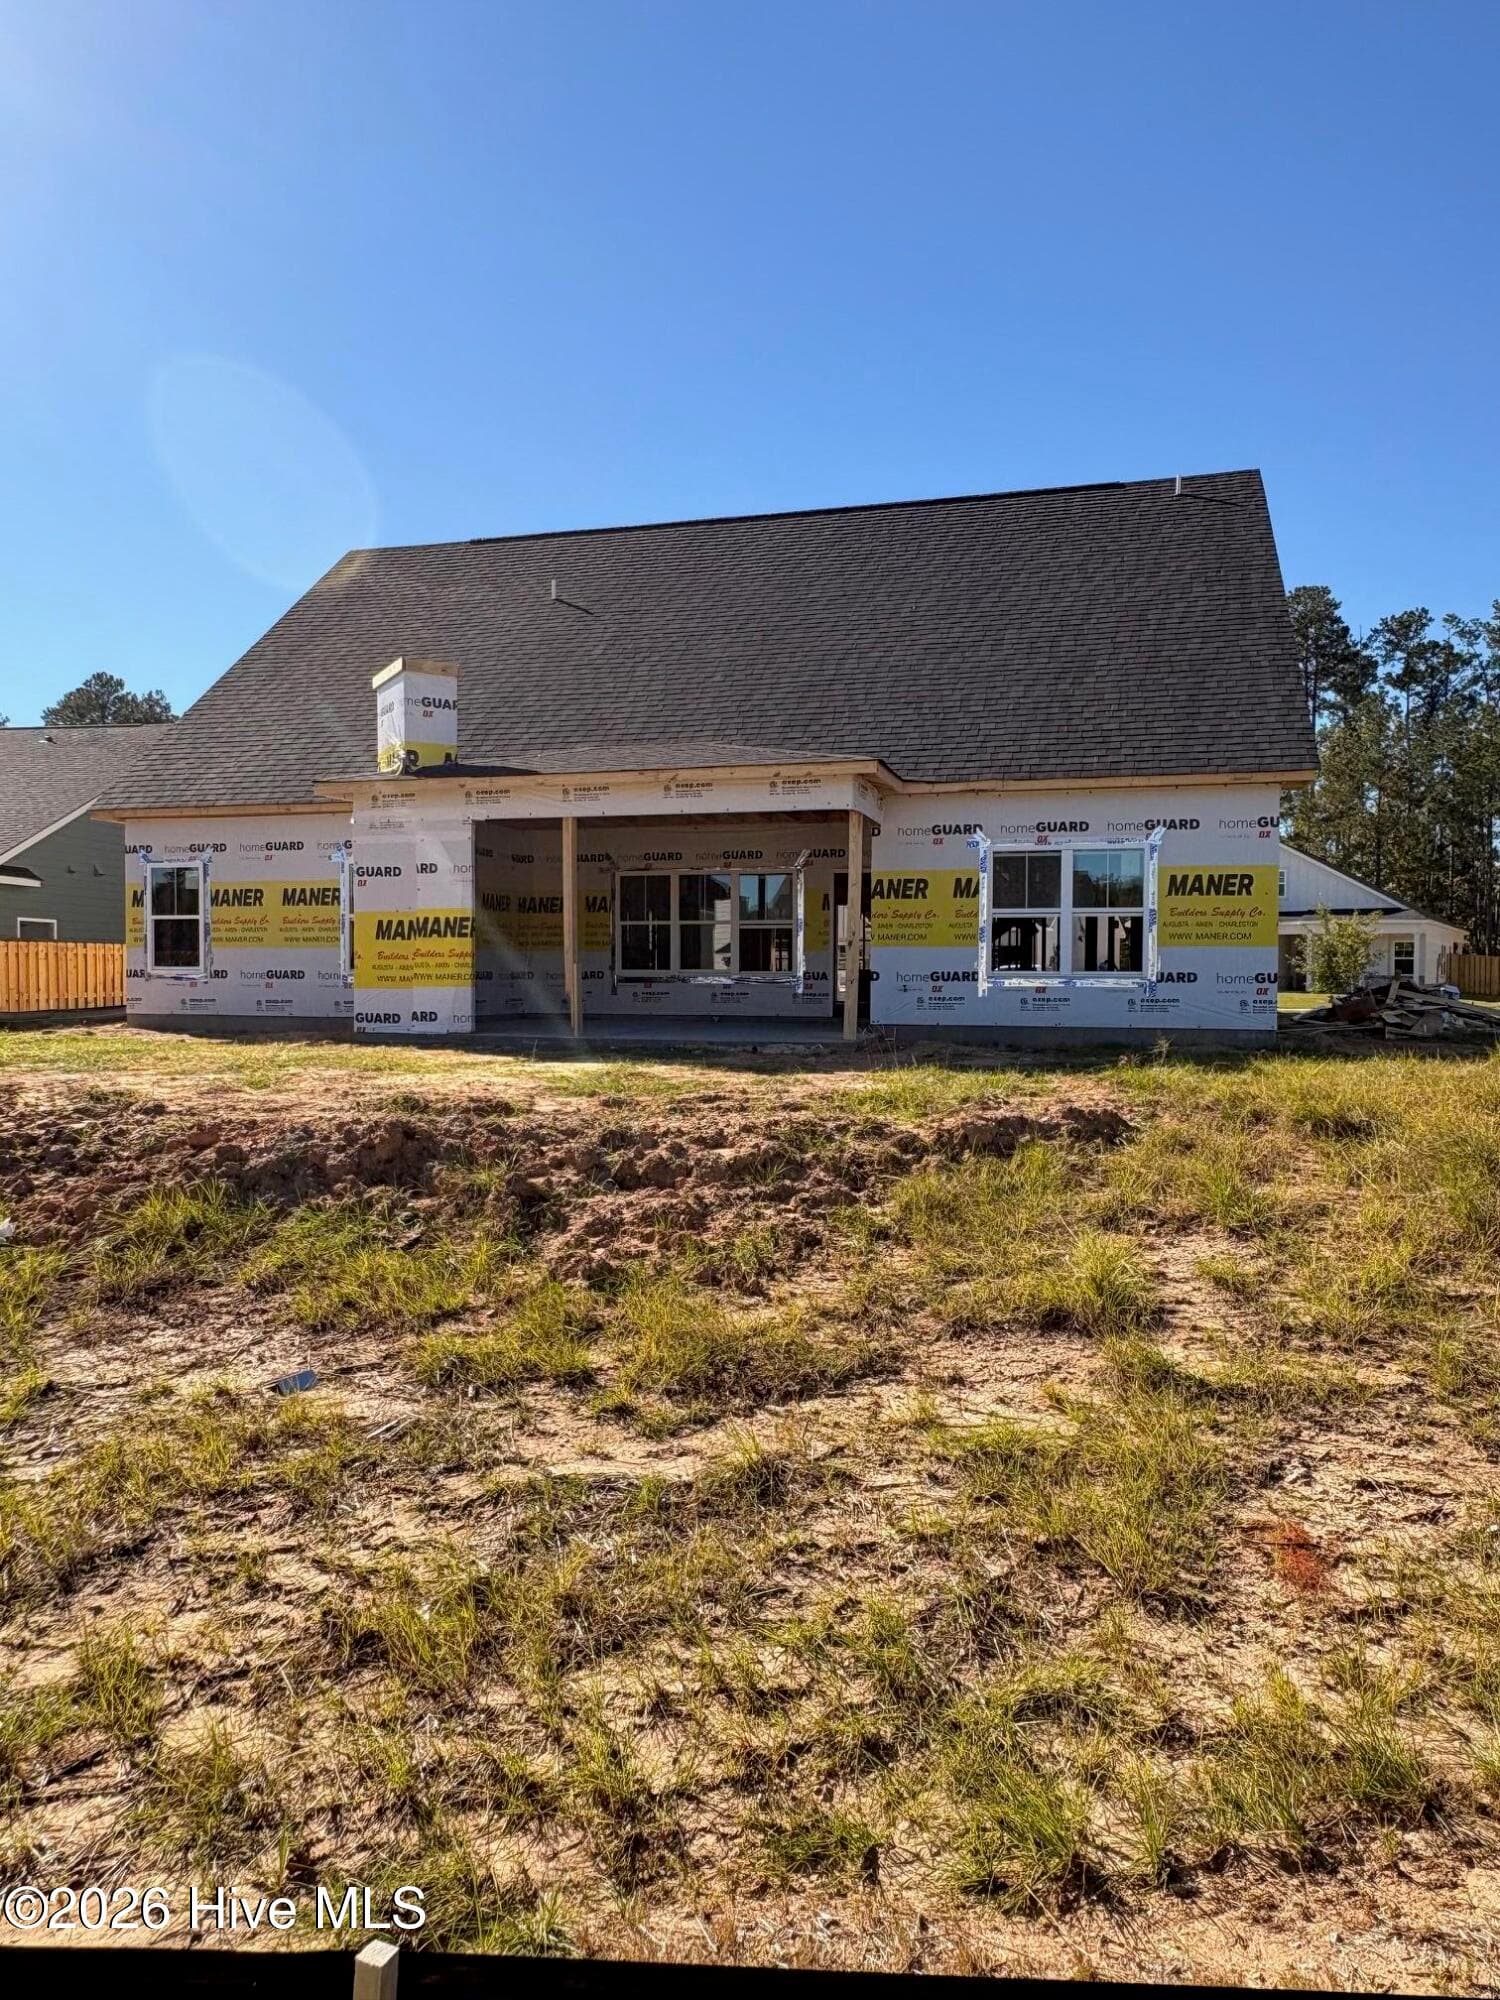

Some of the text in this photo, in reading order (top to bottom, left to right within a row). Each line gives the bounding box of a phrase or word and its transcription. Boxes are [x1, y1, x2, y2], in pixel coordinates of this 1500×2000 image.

[898, 824, 983, 837] homeGUARD
[1001, 821, 1089, 833] homeGUARD
[1107, 819, 1200, 831] homeGUARD
[239, 841, 304, 853] homeGUARD
[356, 866, 402, 877] GUARD
[1165, 873, 1254, 897] MANER
[282, 887, 341, 906] MANER
[1169, 905, 1266, 919] Builders Supply Co.
[240, 969, 305, 980] homeGUARD
[896, 970, 979, 983] homeGUARD
[355, 1012, 401, 1024] GUARD
